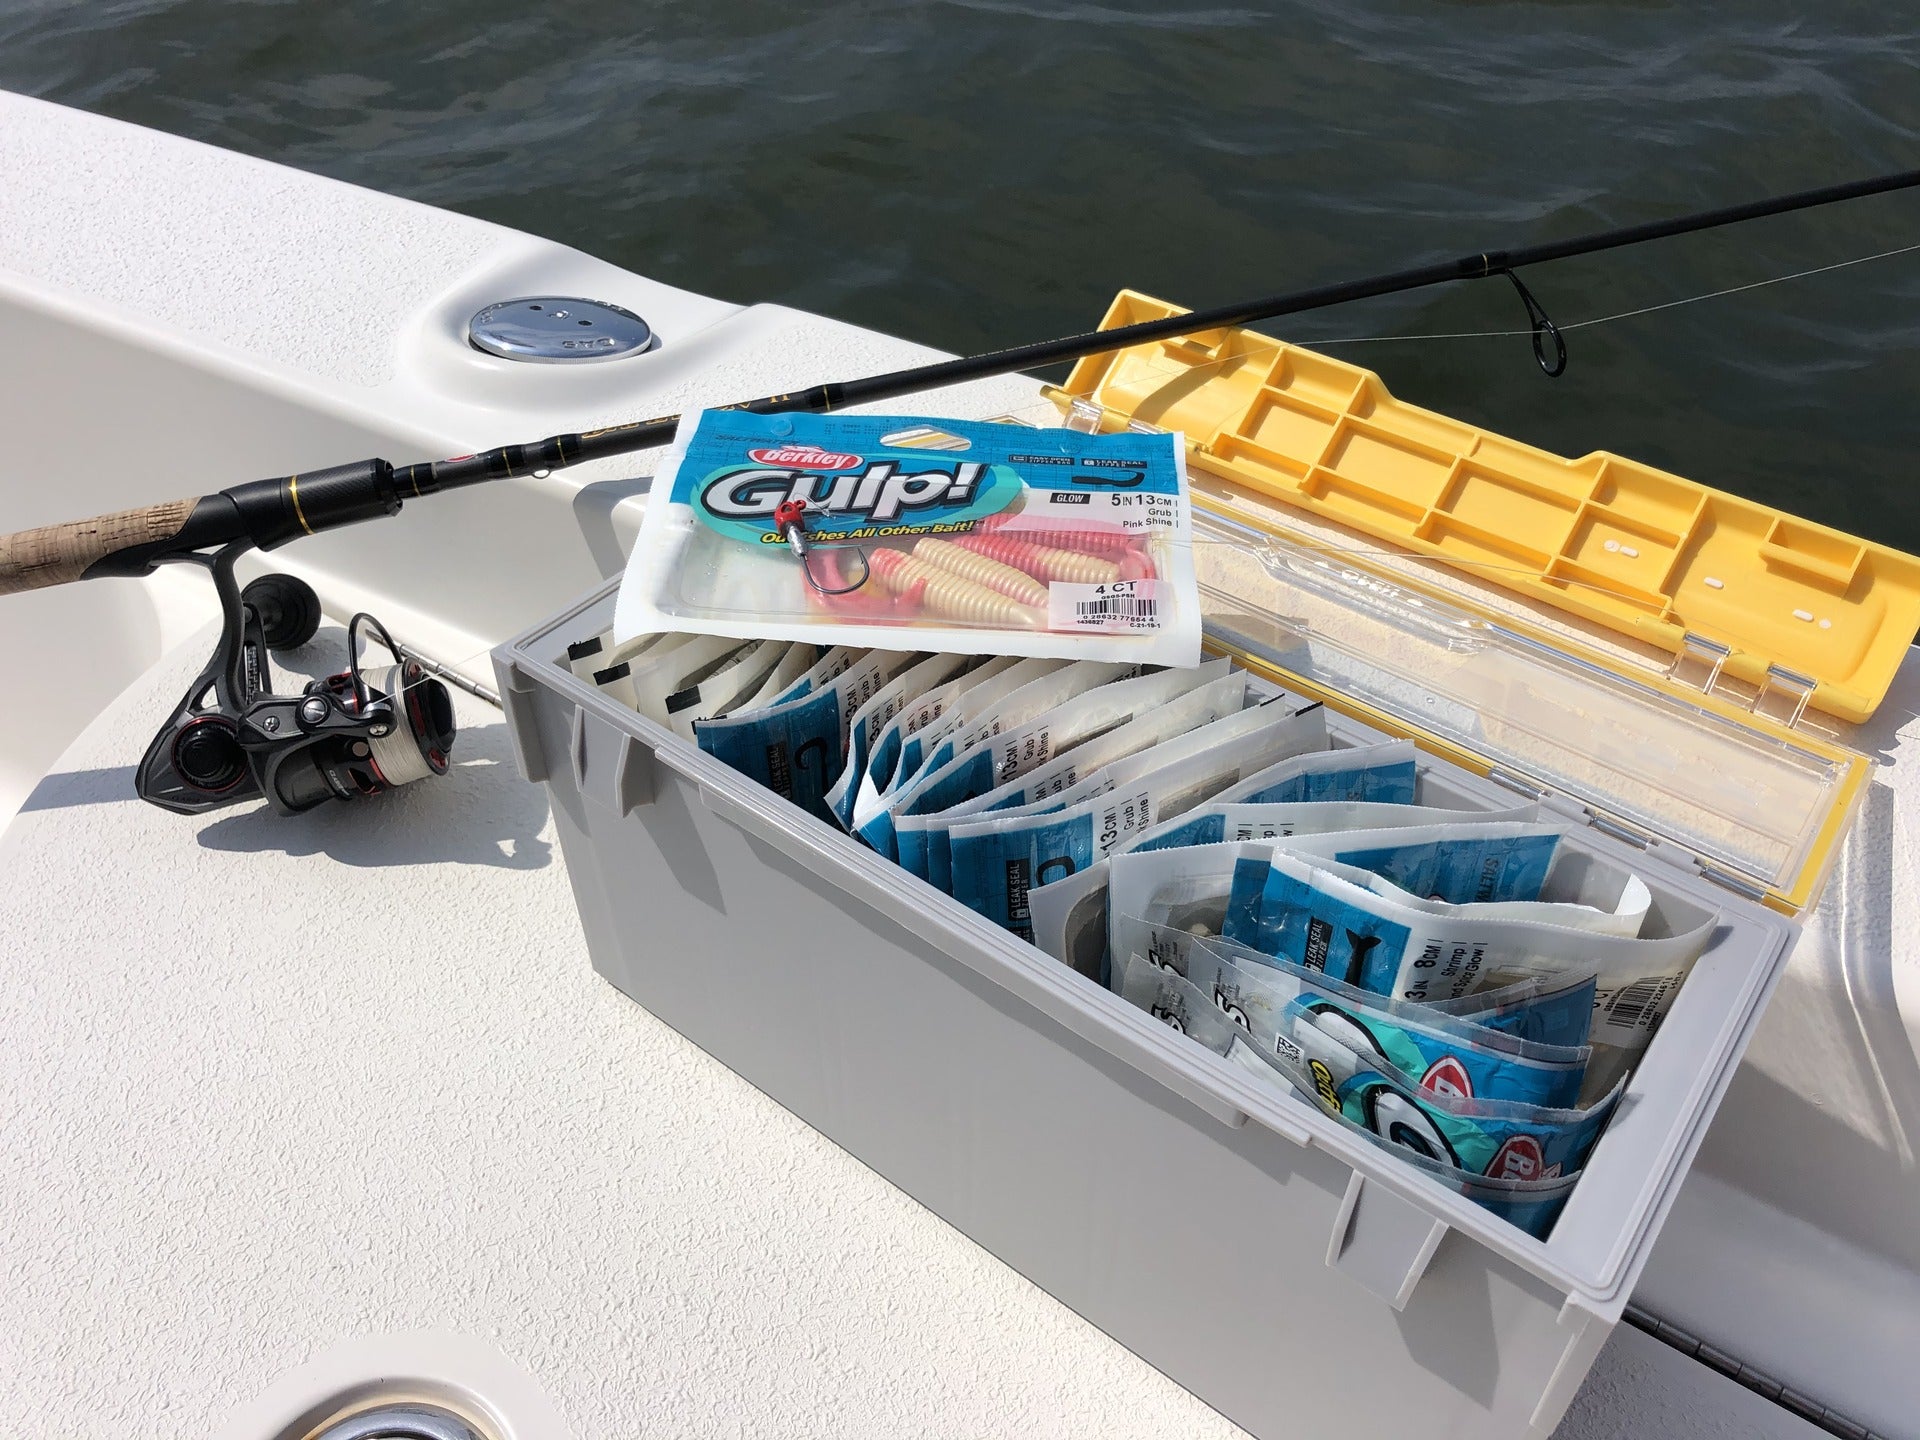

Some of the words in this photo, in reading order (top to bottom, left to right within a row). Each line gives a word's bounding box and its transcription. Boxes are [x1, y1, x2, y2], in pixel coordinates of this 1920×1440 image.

[762, 448, 851, 469] Berkley
[702, 460, 986, 521] Gulp!
[1056, 494, 1084, 503] GLOW
[1123, 520, 1143, 528] Pink
[1145, 517, 1173, 527] Shine
[1148, 508, 1172, 517] Grub
[761, 527, 845, 544] Oushes
[847, 526, 874, 539] All
[878, 523, 928, 538] Other
[932, 520, 974, 535] Bait!
[1095, 585, 1106, 594] 4
[1112, 581, 1137, 592] CT
[1023, 738, 1034, 761] Grub
[1036, 731, 1049, 757] Shine
[1123, 805, 1134, 831] Grub
[1137, 798, 1149, 826] Shine
[1100, 812, 1118, 851] 13CM
[1010, 863, 1020, 885] SEAL
[1010, 885, 1021, 908] LEAK
[1312, 923, 1323, 945] SEAL
[1307, 946, 1318, 964] LEAK
[1316, 940, 1327, 968] ZIPPER
[1441, 947, 1467, 977] Shrimp
[1465, 948, 1485, 975] Glow
